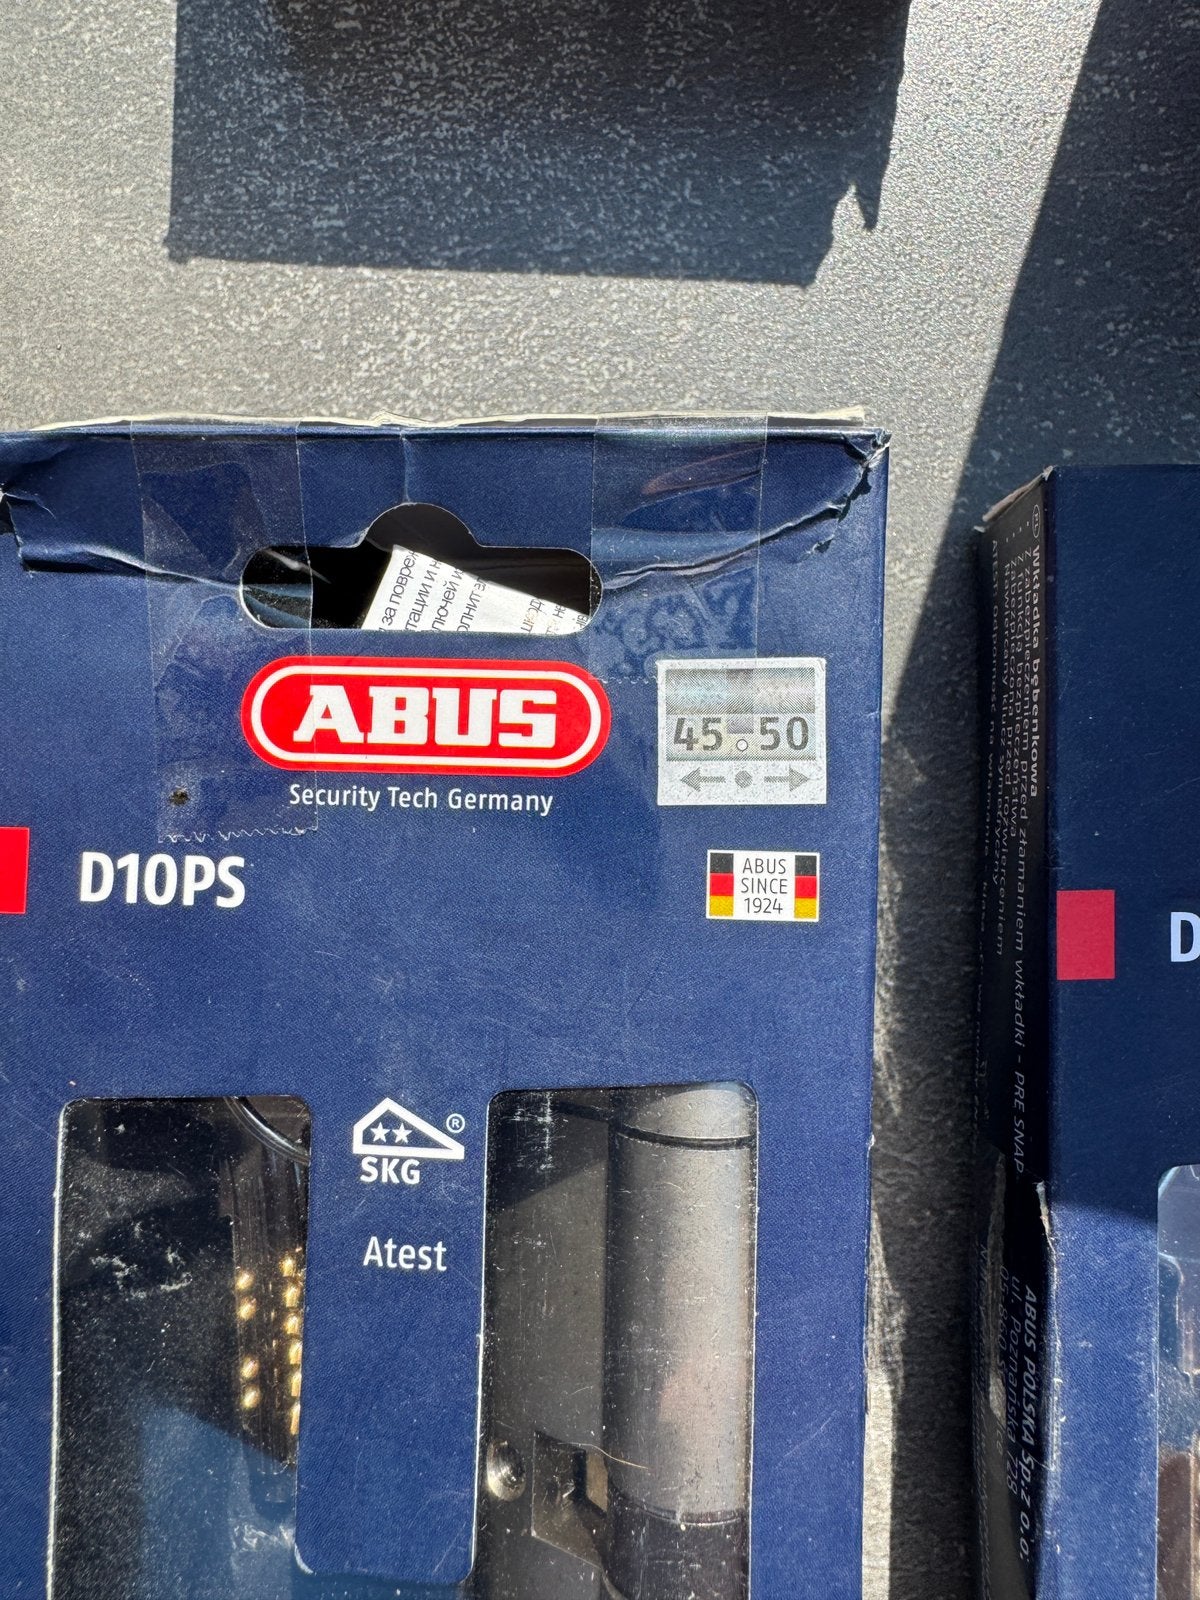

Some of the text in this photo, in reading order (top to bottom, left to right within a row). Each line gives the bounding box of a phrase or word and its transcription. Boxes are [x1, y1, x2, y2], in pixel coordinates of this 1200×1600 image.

[382, 606, 398, 626] за
[1030, 544, 1041, 798] Wkładka bębenkowa
[292, 684, 558, 749] ABUS
[673, 716, 810, 751] 45 50
[289, 784, 553, 816] Security Tech Germany
[1019, 759, 1029, 820] przed
[79, 851, 247, 909] D10PS
[740, 877, 788, 894] SINCE
[742, 858, 787, 875] ABUS
[1015, 827, 1028, 952] złamaniem
[743, 897, 784, 914] 1924
[1014, 959, 1026, 1048] wkładki
[360, 1155, 421, 1185] SKG
[1014, 1115, 1026, 1174] SNAP
[362, 1235, 448, 1272] Atest
[1024, 1284, 1037, 1353] ABUS
[1006, 1275, 1023, 1495] ul. Poznańska 728
[1021, 1355, 1037, 1446] POLSKA
